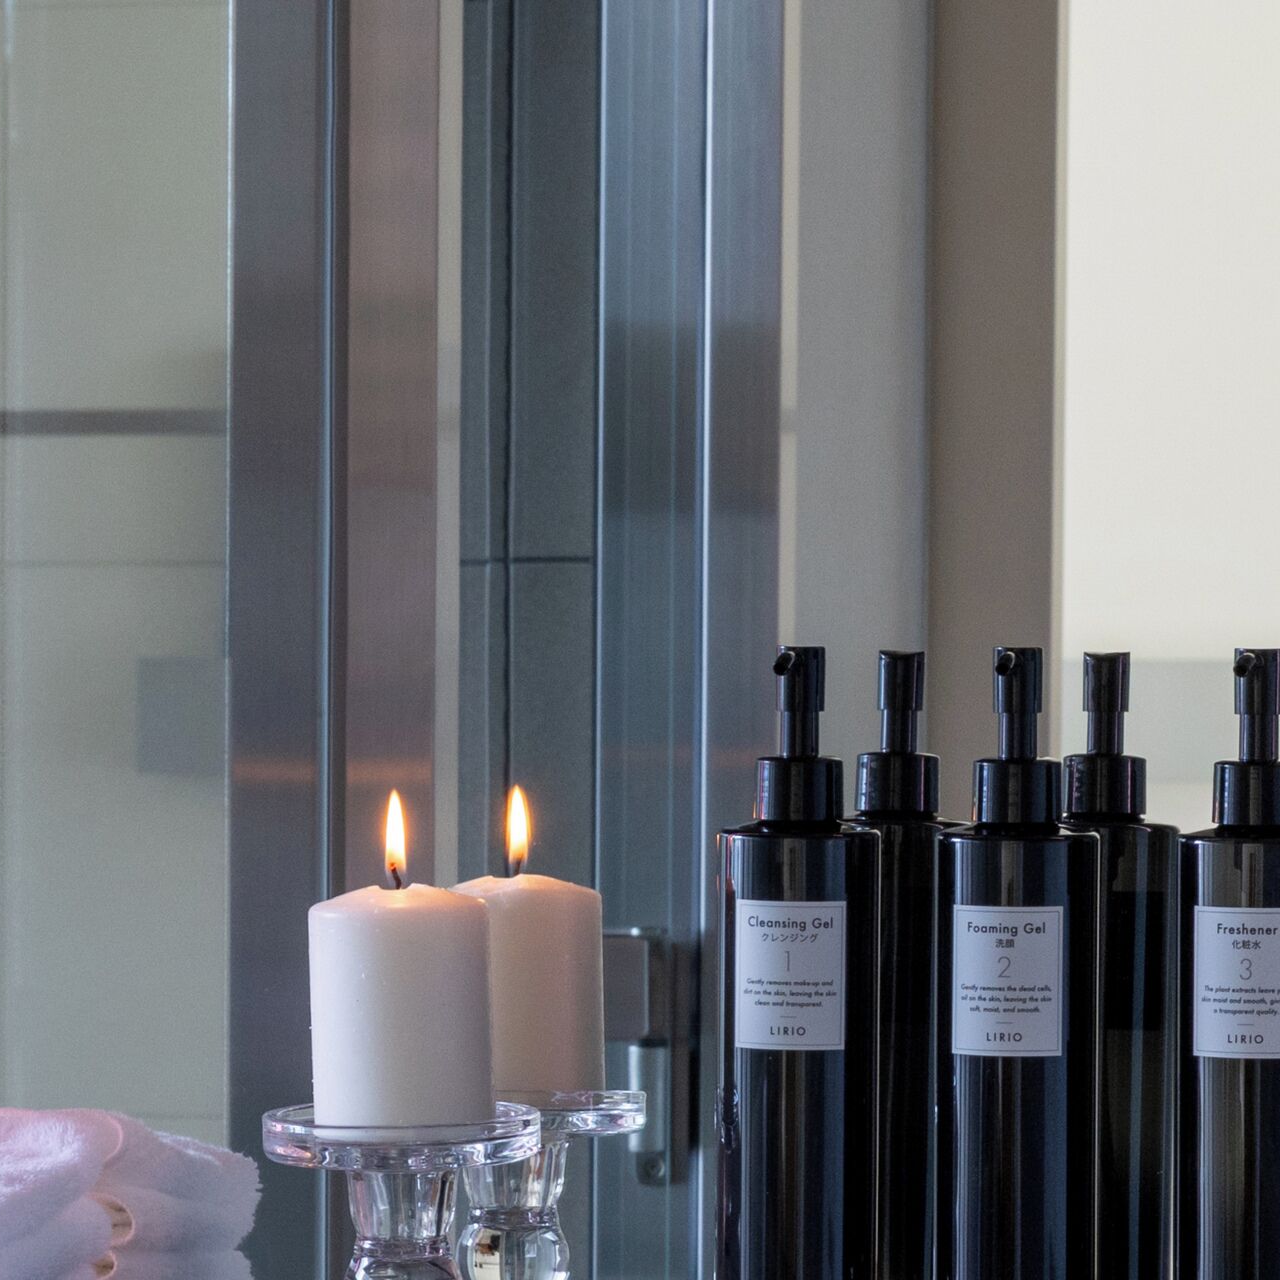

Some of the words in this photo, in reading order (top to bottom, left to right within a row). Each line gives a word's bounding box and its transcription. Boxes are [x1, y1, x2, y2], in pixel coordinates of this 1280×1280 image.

[748, 915, 807, 931] Cleansing
[812, 917, 834, 929] Gel
[967, 922, 1018, 936] Foaming
[1023, 922, 1046, 934] Gel
[1217, 923, 1279, 935] Freshener
[761, 933, 819, 943] クレンジング
[995, 939, 1015, 948] 洗顔
[1232, 940, 1262, 950] 化粧水
[998, 956, 1011, 978] 2
[1239, 958, 1253, 981] 3
[746, 978, 764, 986] Gently
[961, 984, 978, 992] Gently
[789, 990, 812, 998] leaving
[770, 1027, 807, 1036] LIRIO
[986, 1033, 1023, 1042] LIRIO
[1227, 1034, 1264, 1044] LIRIO
